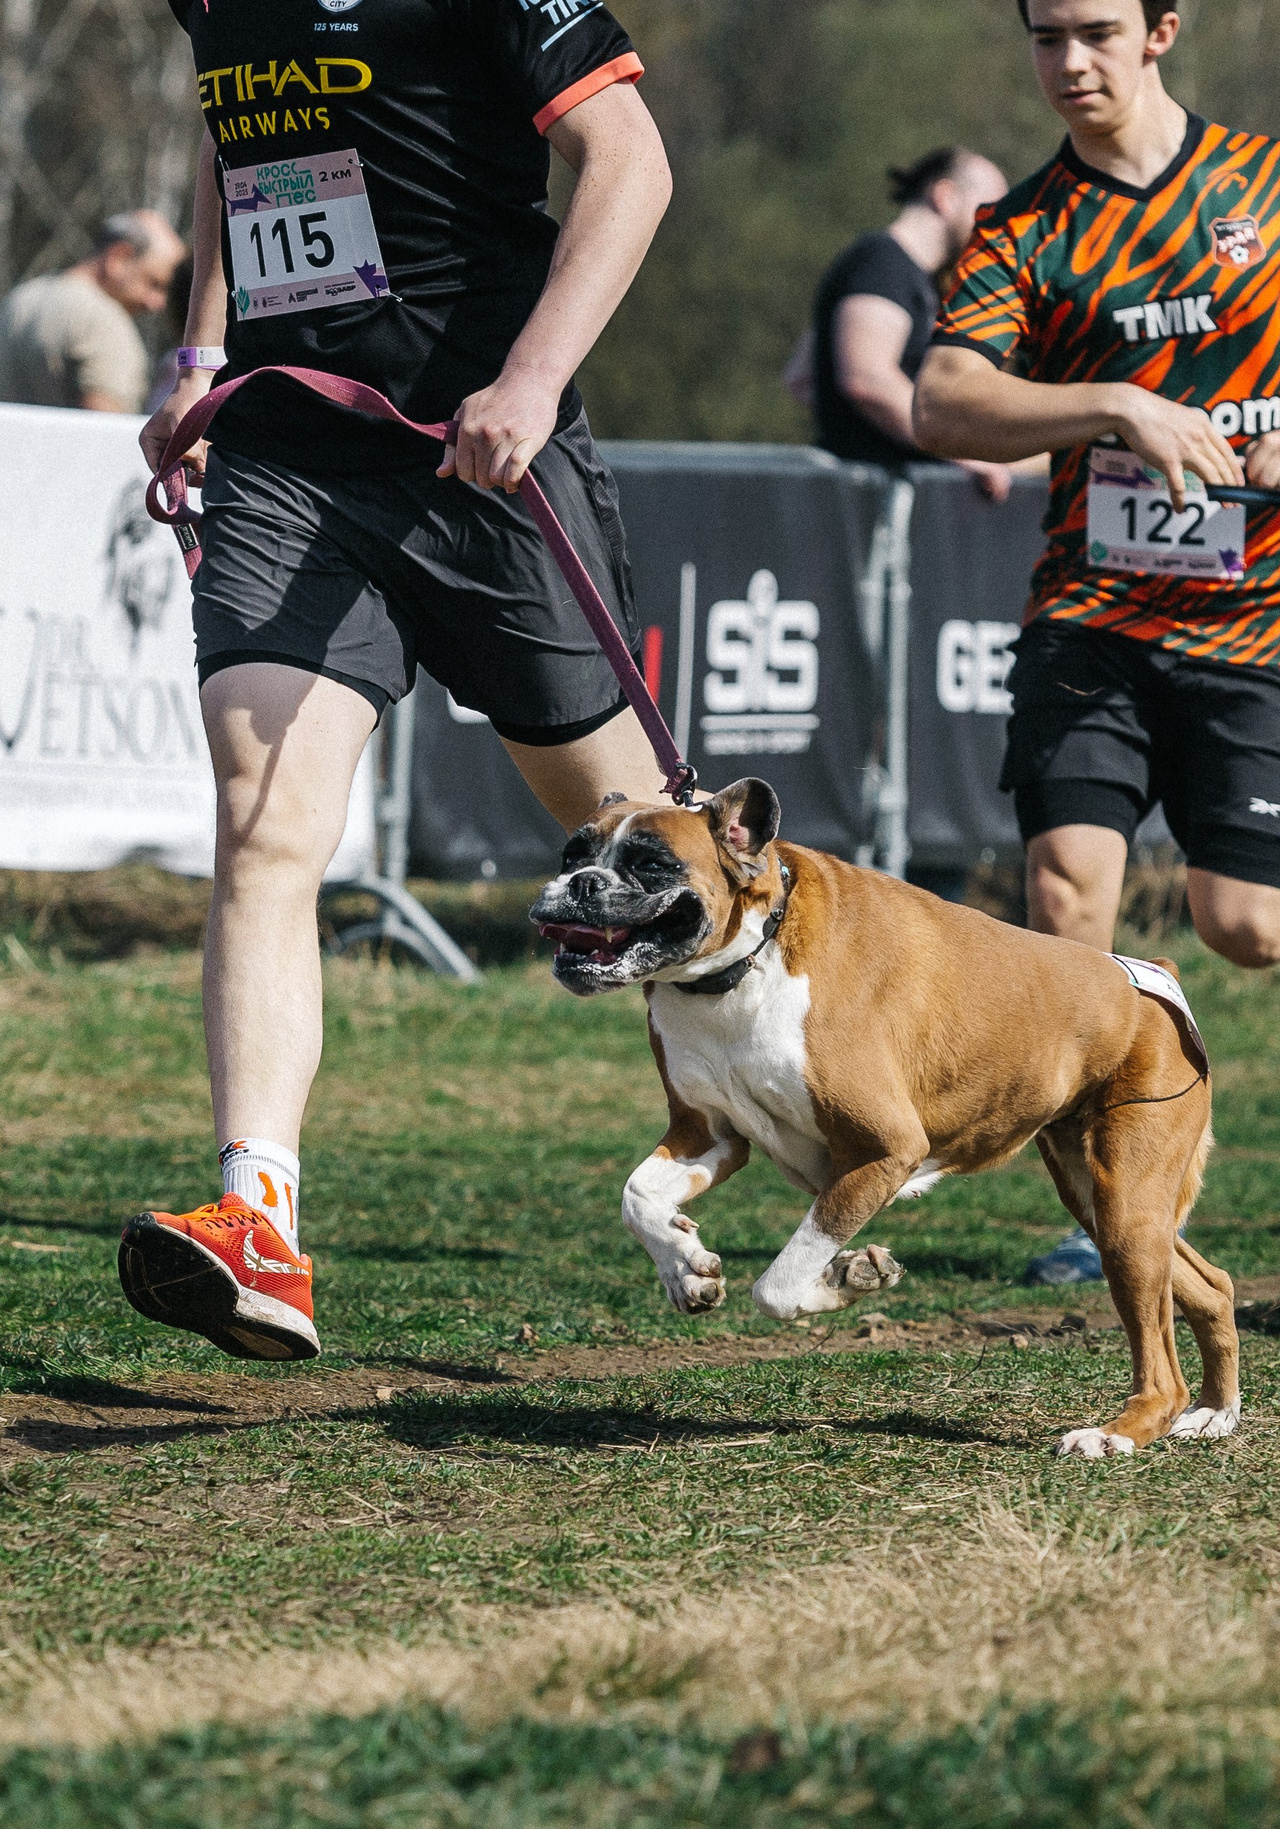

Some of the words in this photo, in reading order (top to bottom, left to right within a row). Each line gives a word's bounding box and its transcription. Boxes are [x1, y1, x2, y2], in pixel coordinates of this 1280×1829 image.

[314, 22, 327, 31] 125
[329, 22, 359, 31] YEARS
[540, 0, 598, 25] TIR
[197, 57, 372, 110] ETIHAD
[219, 107, 331, 143] AIRWAYS
[318, 171, 329, 182] 2
[250, 211, 335, 278] 115
[1119, 496, 1206, 546] 122
